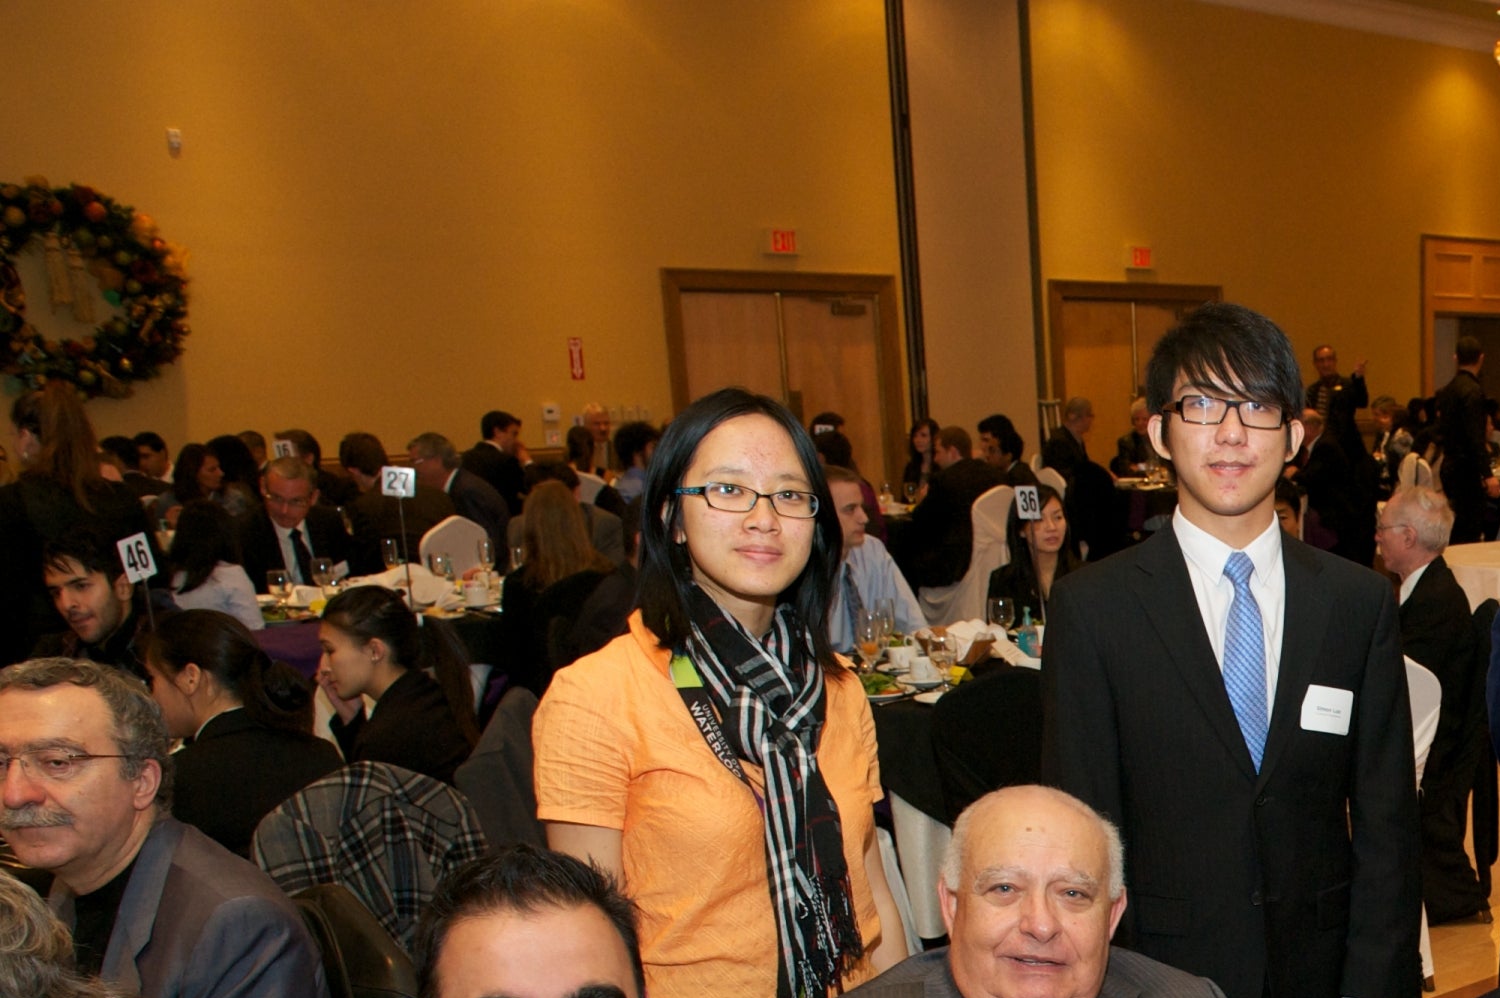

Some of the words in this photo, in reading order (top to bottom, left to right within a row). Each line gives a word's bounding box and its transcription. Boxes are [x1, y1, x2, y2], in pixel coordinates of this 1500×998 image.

[387, 471, 409, 490] 27
[1019, 490, 1037, 512] 36
[127, 540, 150, 572] 46
[690, 701, 742, 778] WATERLOO
[702, 704, 732, 756] UNIVERSITY
